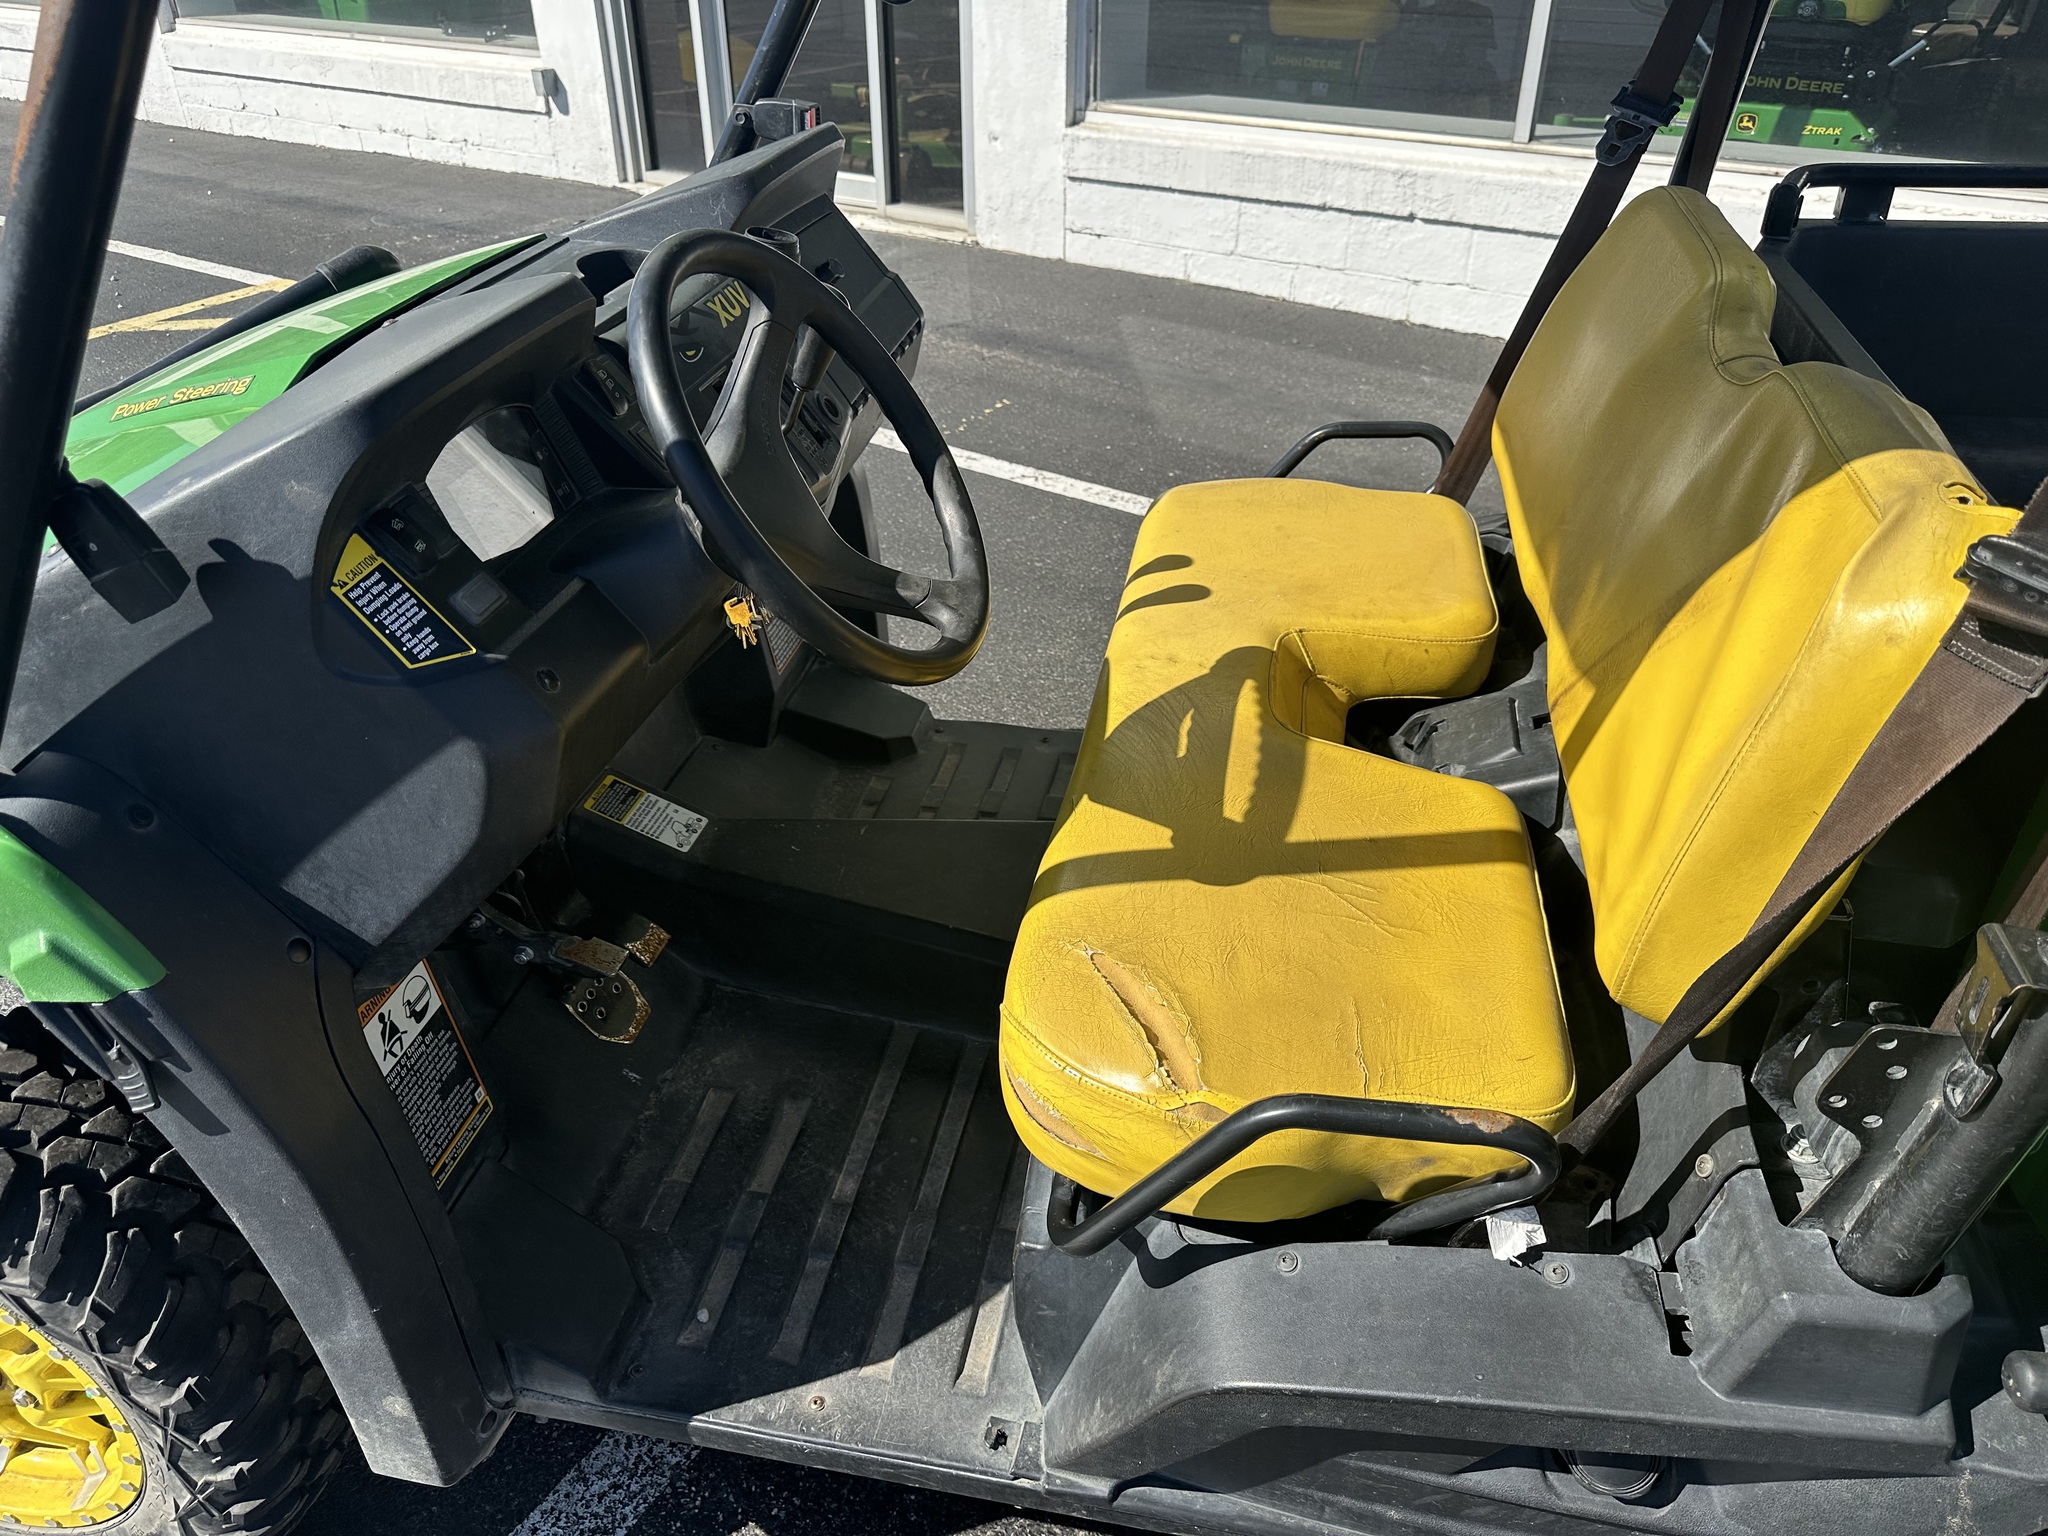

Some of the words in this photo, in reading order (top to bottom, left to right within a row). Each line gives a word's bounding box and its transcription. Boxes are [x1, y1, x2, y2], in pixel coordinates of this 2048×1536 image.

[1746, 75, 1782, 89] OHN
[1785, 76, 1845, 94] DEERE
[1801, 124, 1843, 136] ZTRAK
[706, 280, 750, 328] XUV
[111, 396, 167, 421] Power
[170, 376, 252, 405] Steering
[346, 554, 378, 581] CAUTION
[348, 588, 362, 599] Help
[360, 572, 381, 590] Prevent
[356, 593, 373, 607] Injury
[370, 581, 387, 595] When
[363, 594, 388, 614] Dumping
[384, 582, 402, 597] Loads
[385, 1064, 400, 1083] njury
[405, 1036, 423, 1056] Death
[406, 1044, 426, 1068] Falling
